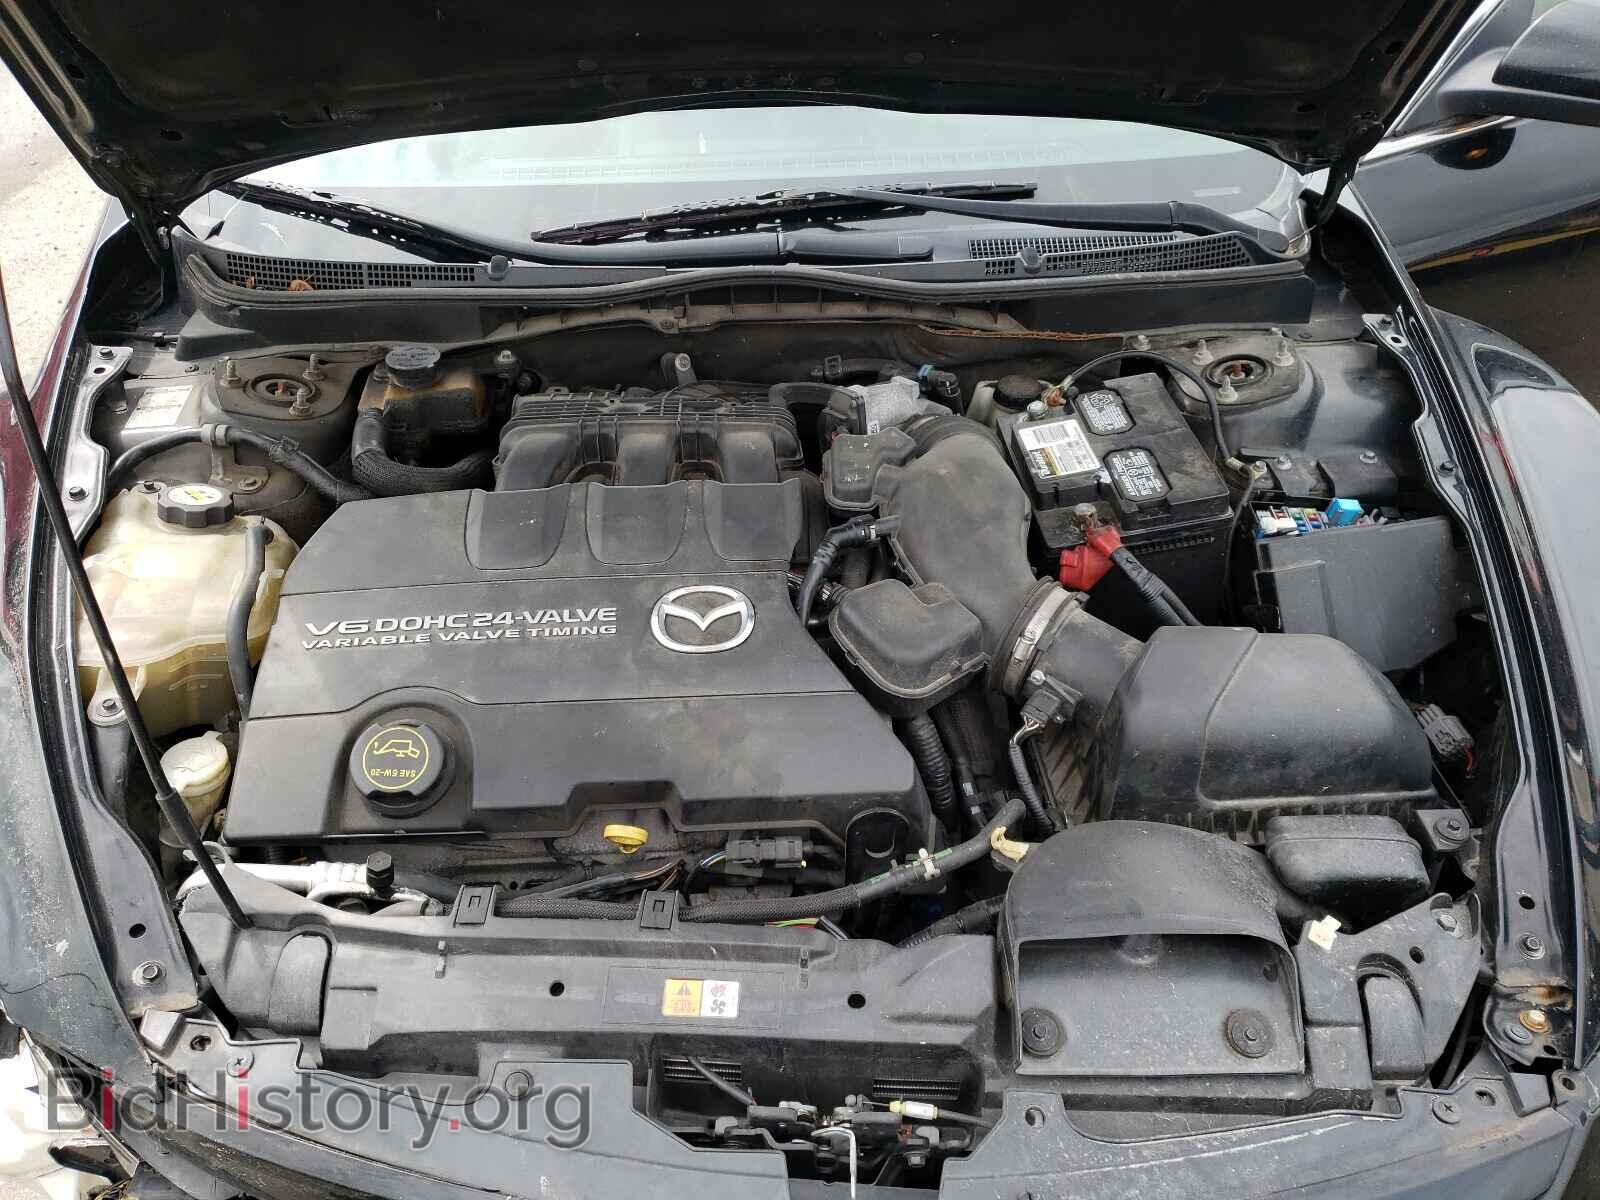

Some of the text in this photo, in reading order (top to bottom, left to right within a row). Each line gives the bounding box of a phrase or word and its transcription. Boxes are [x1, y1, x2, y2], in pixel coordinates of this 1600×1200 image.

[305, 607, 617, 636] V6 DOHC 24-VALVE
[302, 625, 617, 649] VARIABLE VALVE TIMING
[399, 769, 417, 778] SAE
